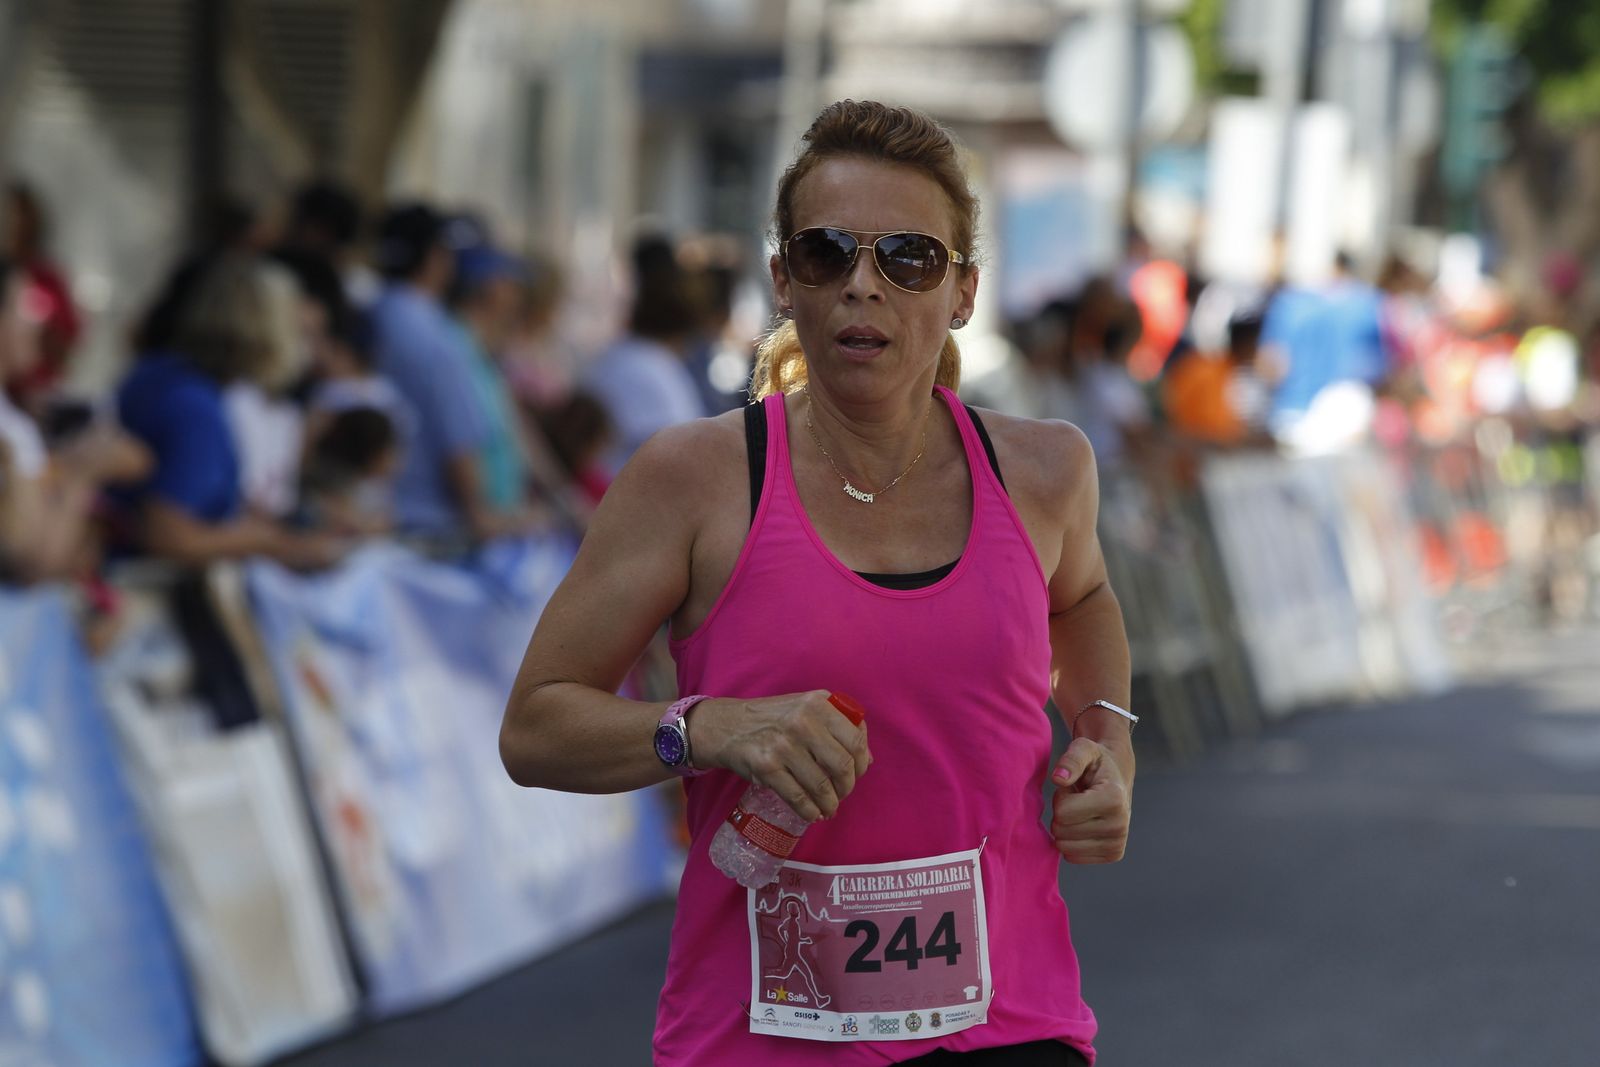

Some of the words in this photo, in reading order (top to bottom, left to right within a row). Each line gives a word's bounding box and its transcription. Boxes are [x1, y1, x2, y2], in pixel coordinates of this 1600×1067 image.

[843, 483, 874, 503] MONICA
[840, 875, 904, 892] CARRERA
[906, 865, 970, 888] SOLIDARIA
[842, 893, 856, 902] POR
[857, 893, 869, 902] LAS
[870, 888, 919, 901] ENFERMEDADES
[919, 886, 935, 896] POCO
[844, 911, 961, 973] 244
[767, 989, 777, 999] La
[787, 992, 808, 1003] Salle
